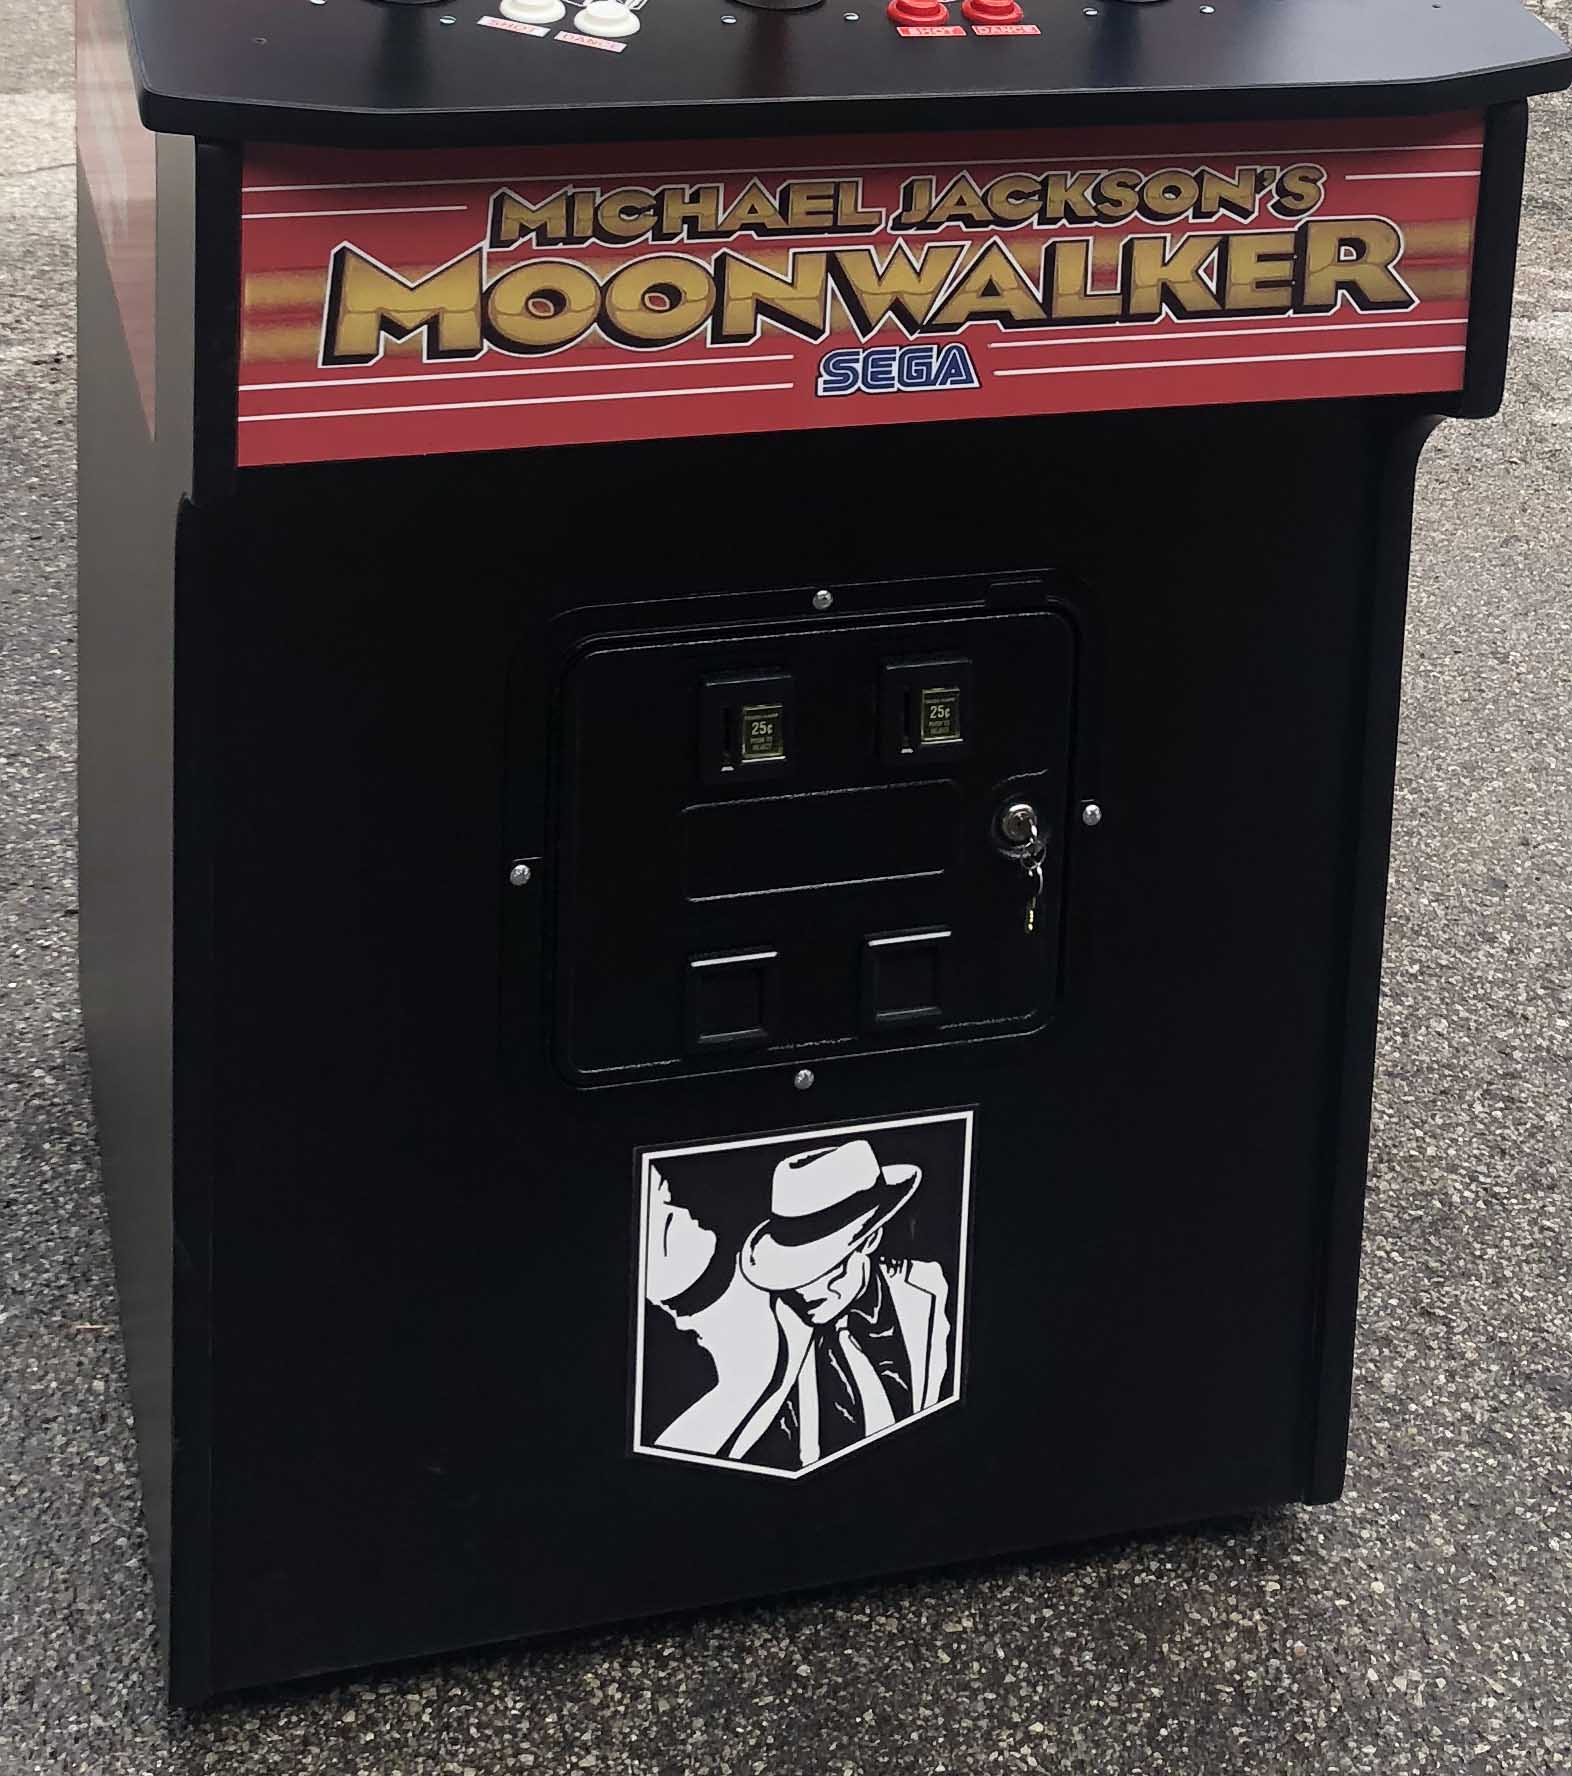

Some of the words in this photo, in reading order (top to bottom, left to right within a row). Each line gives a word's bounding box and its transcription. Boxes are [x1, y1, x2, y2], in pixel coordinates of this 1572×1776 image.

[488, 175, 890, 251] MICHAEL
[892, 163, 1328, 235] JACKSON'S
[320, 213, 1419, 369] MOONWALKER
[817, 344, 981, 397] SEGA
